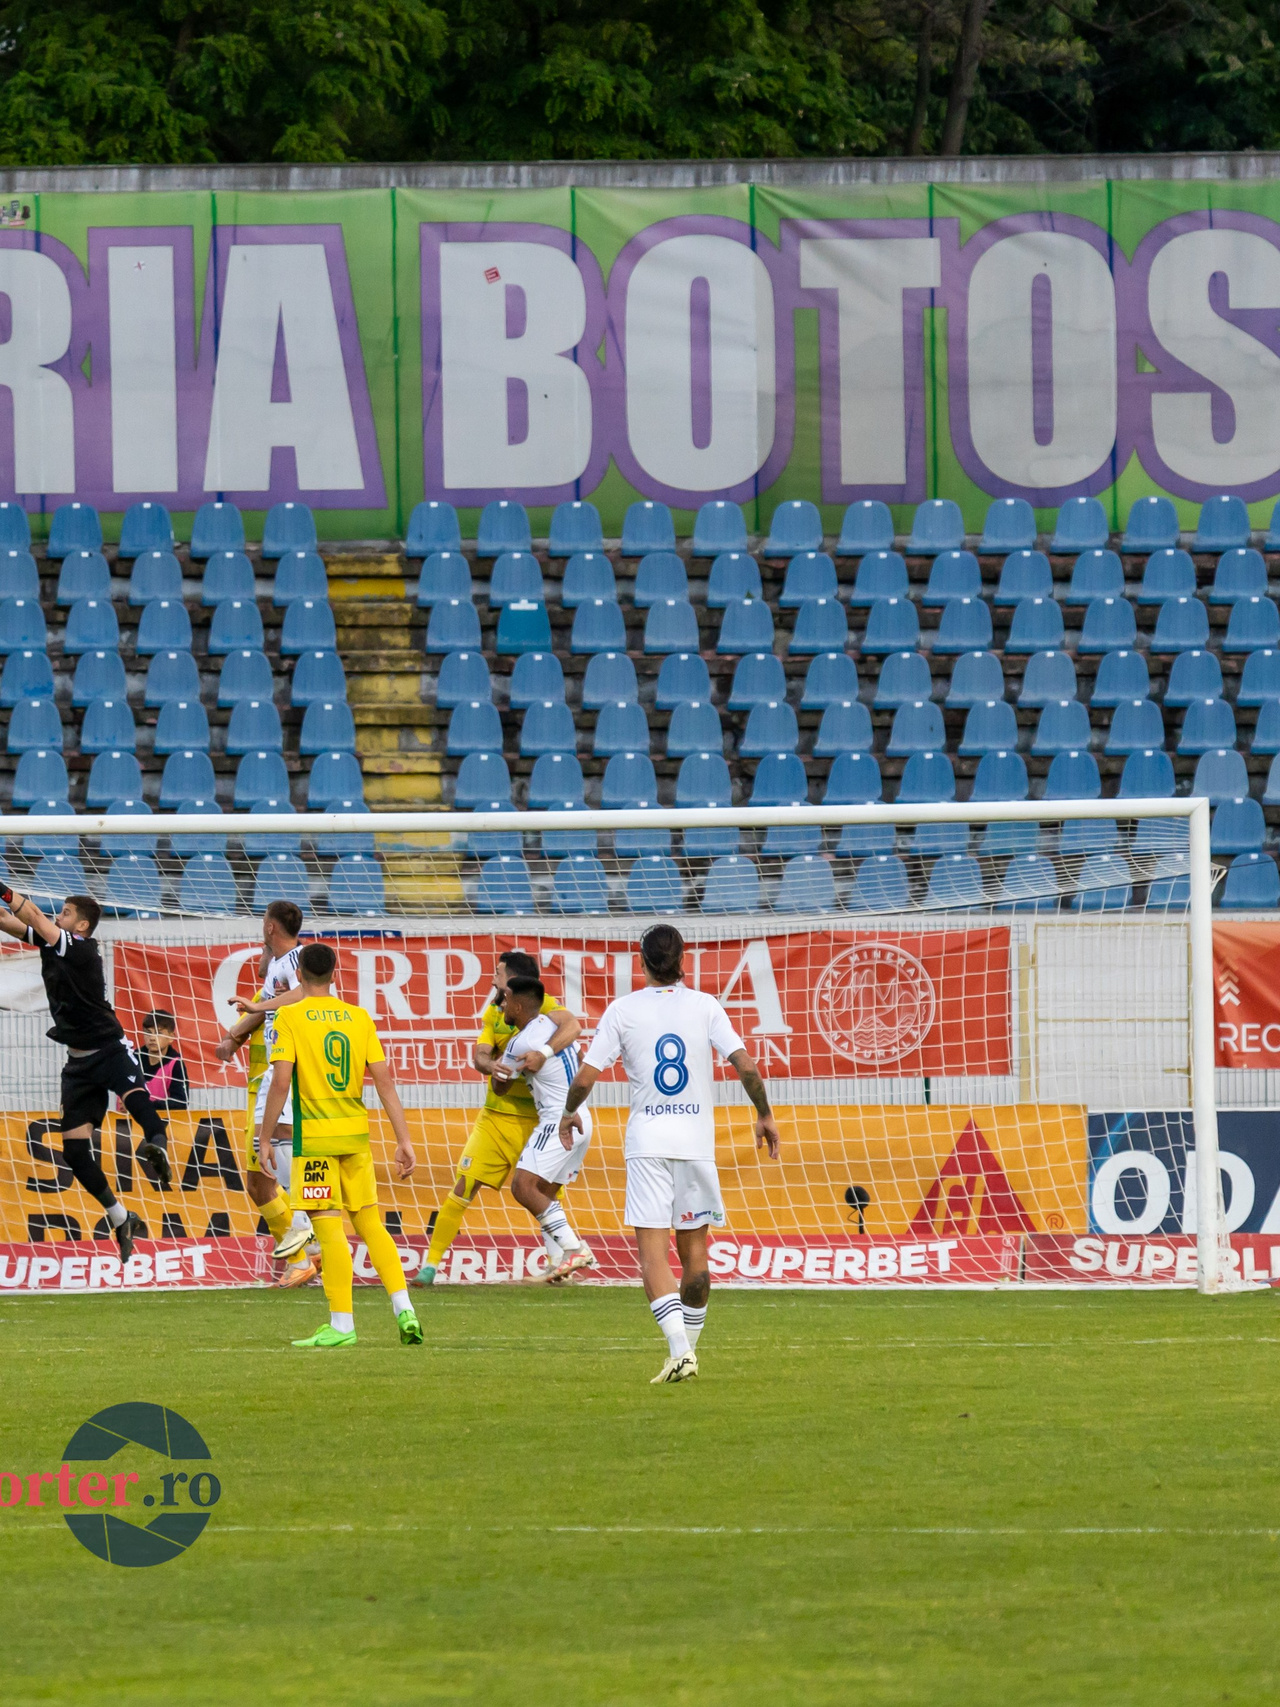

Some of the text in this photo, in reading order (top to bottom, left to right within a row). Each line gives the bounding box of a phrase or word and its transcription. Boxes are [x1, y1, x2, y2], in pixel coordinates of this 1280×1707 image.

[440, 228, 1280, 491] BOTOS
[306, 1009, 352, 1022] GUTEA
[324, 1031, 351, 1091] 9
[653, 1033, 689, 1096] 8
[645, 1104, 700, 1116] FLORESCU
[304, 1161, 329, 1171] APA
[304, 1172, 325, 1182] DIN
[303, 1187, 330, 1199] NOY
[708, 1241, 958, 1280] SUPERBET
